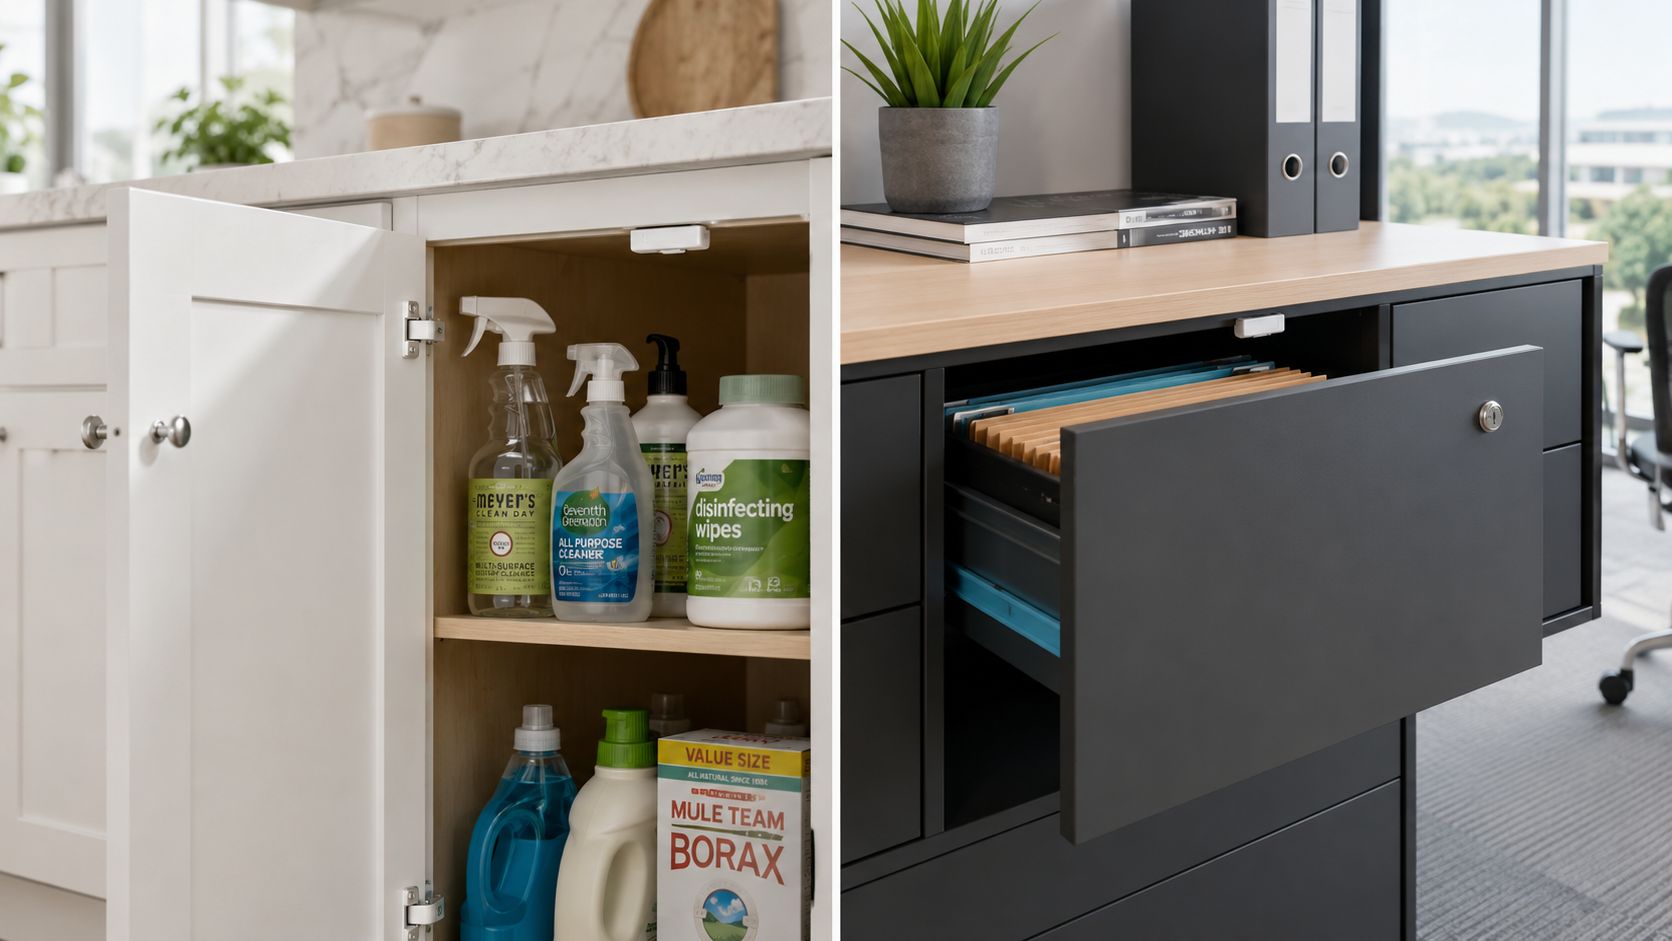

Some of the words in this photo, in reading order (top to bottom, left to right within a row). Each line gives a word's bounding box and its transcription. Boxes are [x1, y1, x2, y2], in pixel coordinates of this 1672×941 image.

[476, 493, 536, 509] MEYER'S
[695, 498, 794, 522] disinfecting
[475, 510, 509, 518] CLEAN
[513, 510, 535, 518] DAY
[695, 519, 742, 543] wipes
[559, 537, 574, 548] ALL
[574, 537, 623, 549] PURPOSE
[685, 747, 733, 767] VALUE
[737, 752, 771, 770] SIZE
[671, 800, 724, 824] MULE
[728, 806, 785, 831] TEAM
[670, 831, 785, 886] BORAX
